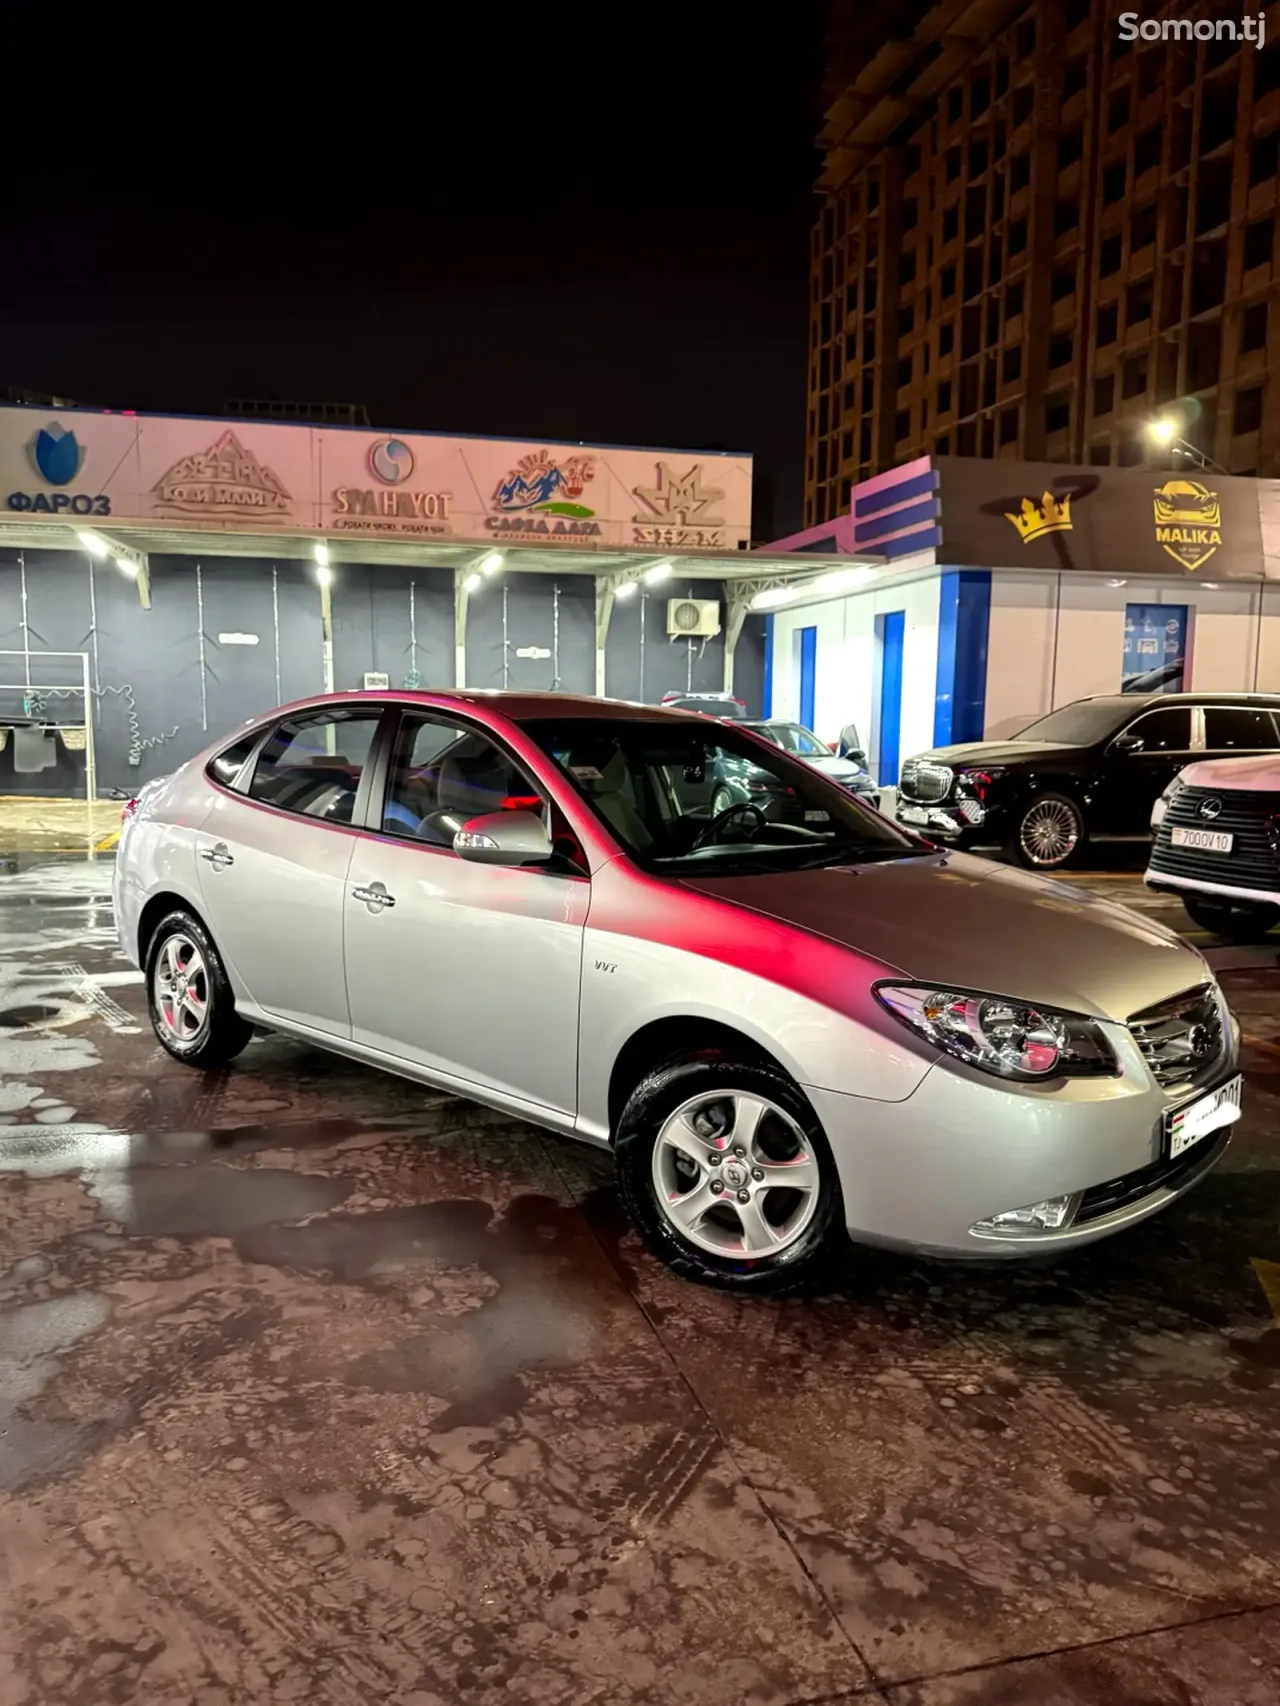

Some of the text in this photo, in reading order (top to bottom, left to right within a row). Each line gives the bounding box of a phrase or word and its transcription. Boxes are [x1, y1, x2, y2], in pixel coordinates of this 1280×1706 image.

[7, 491, 111, 516] ФАРОЗ
[1156, 527, 1222, 545] MALIKA
[595, 960, 618, 973] VVT
